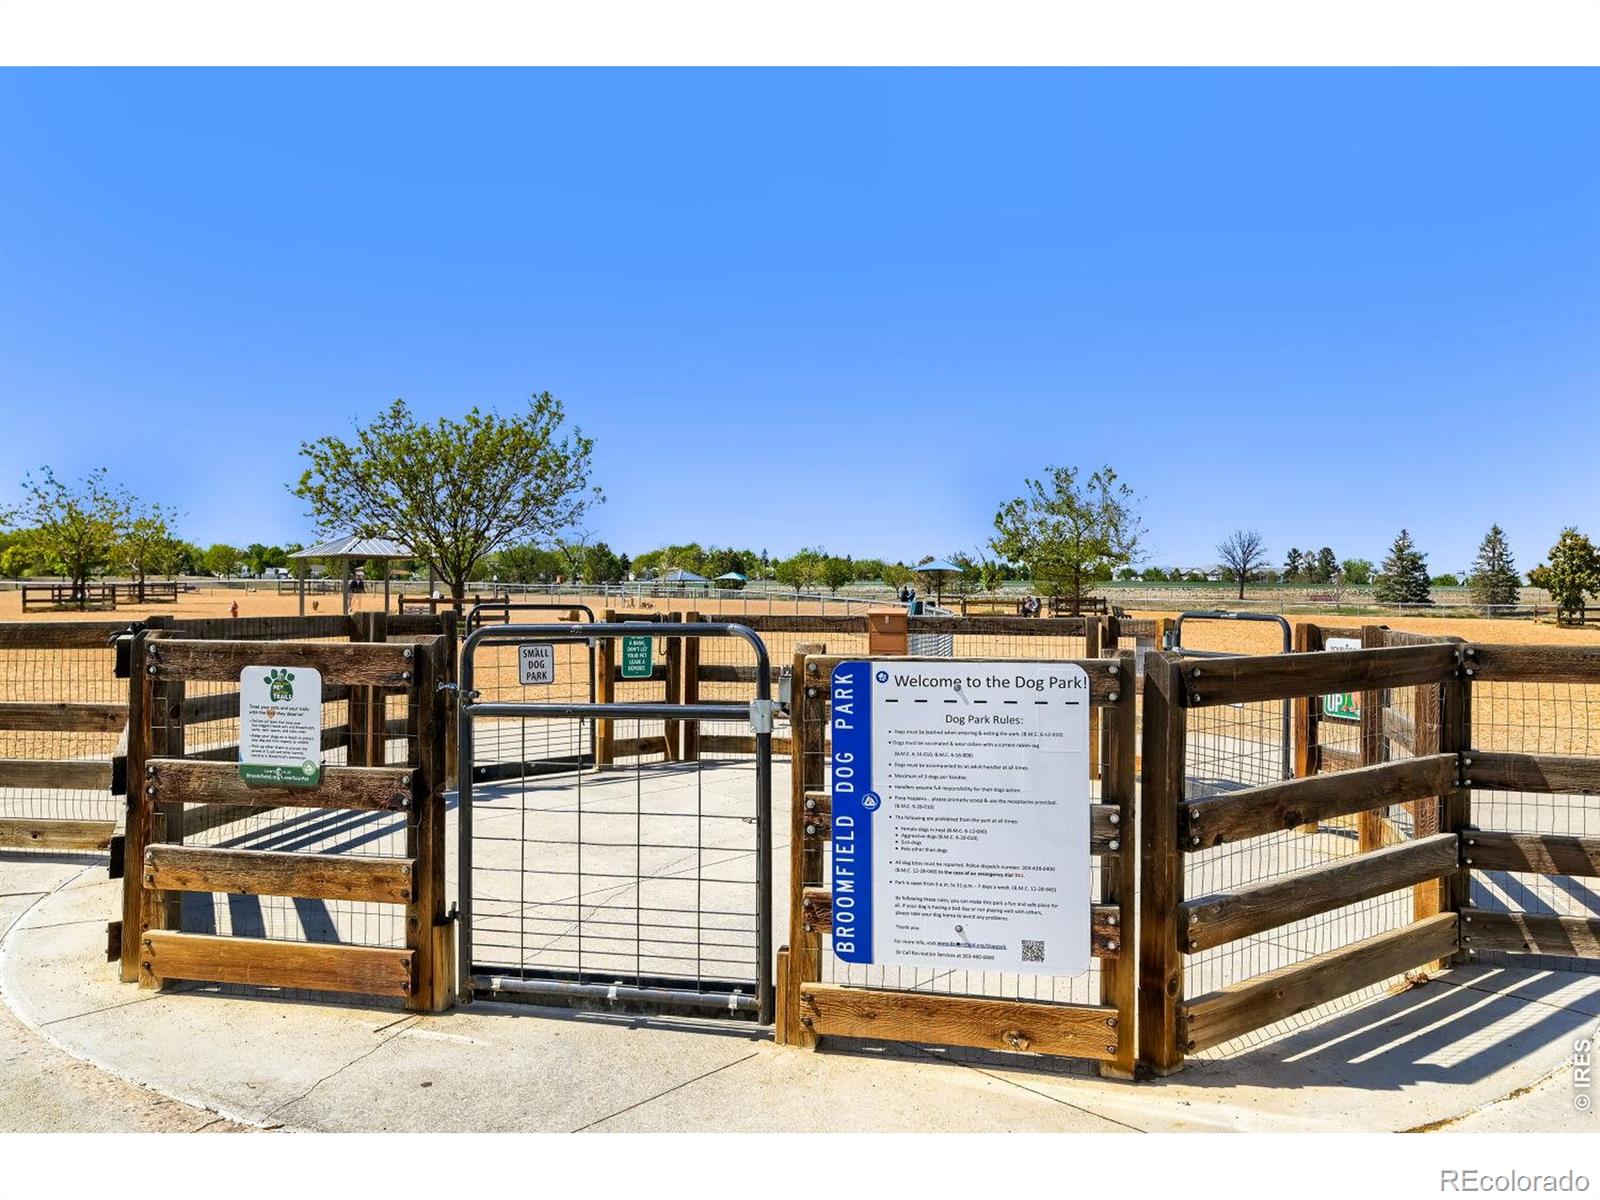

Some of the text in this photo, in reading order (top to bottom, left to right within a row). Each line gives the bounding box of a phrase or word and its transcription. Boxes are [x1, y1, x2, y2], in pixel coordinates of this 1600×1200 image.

[523, 649, 548, 658] SMALL
[528, 660, 545, 669] DOG
[526, 672, 547, 680] PARK
[894, 674, 1087, 691] Welcome to the Dog Park!
[1327, 694, 1342, 712] UP
[945, 715, 1024, 726] Dog Park Rules:
[835, 674, 855, 953] BROOMFIELD DOG PARK
